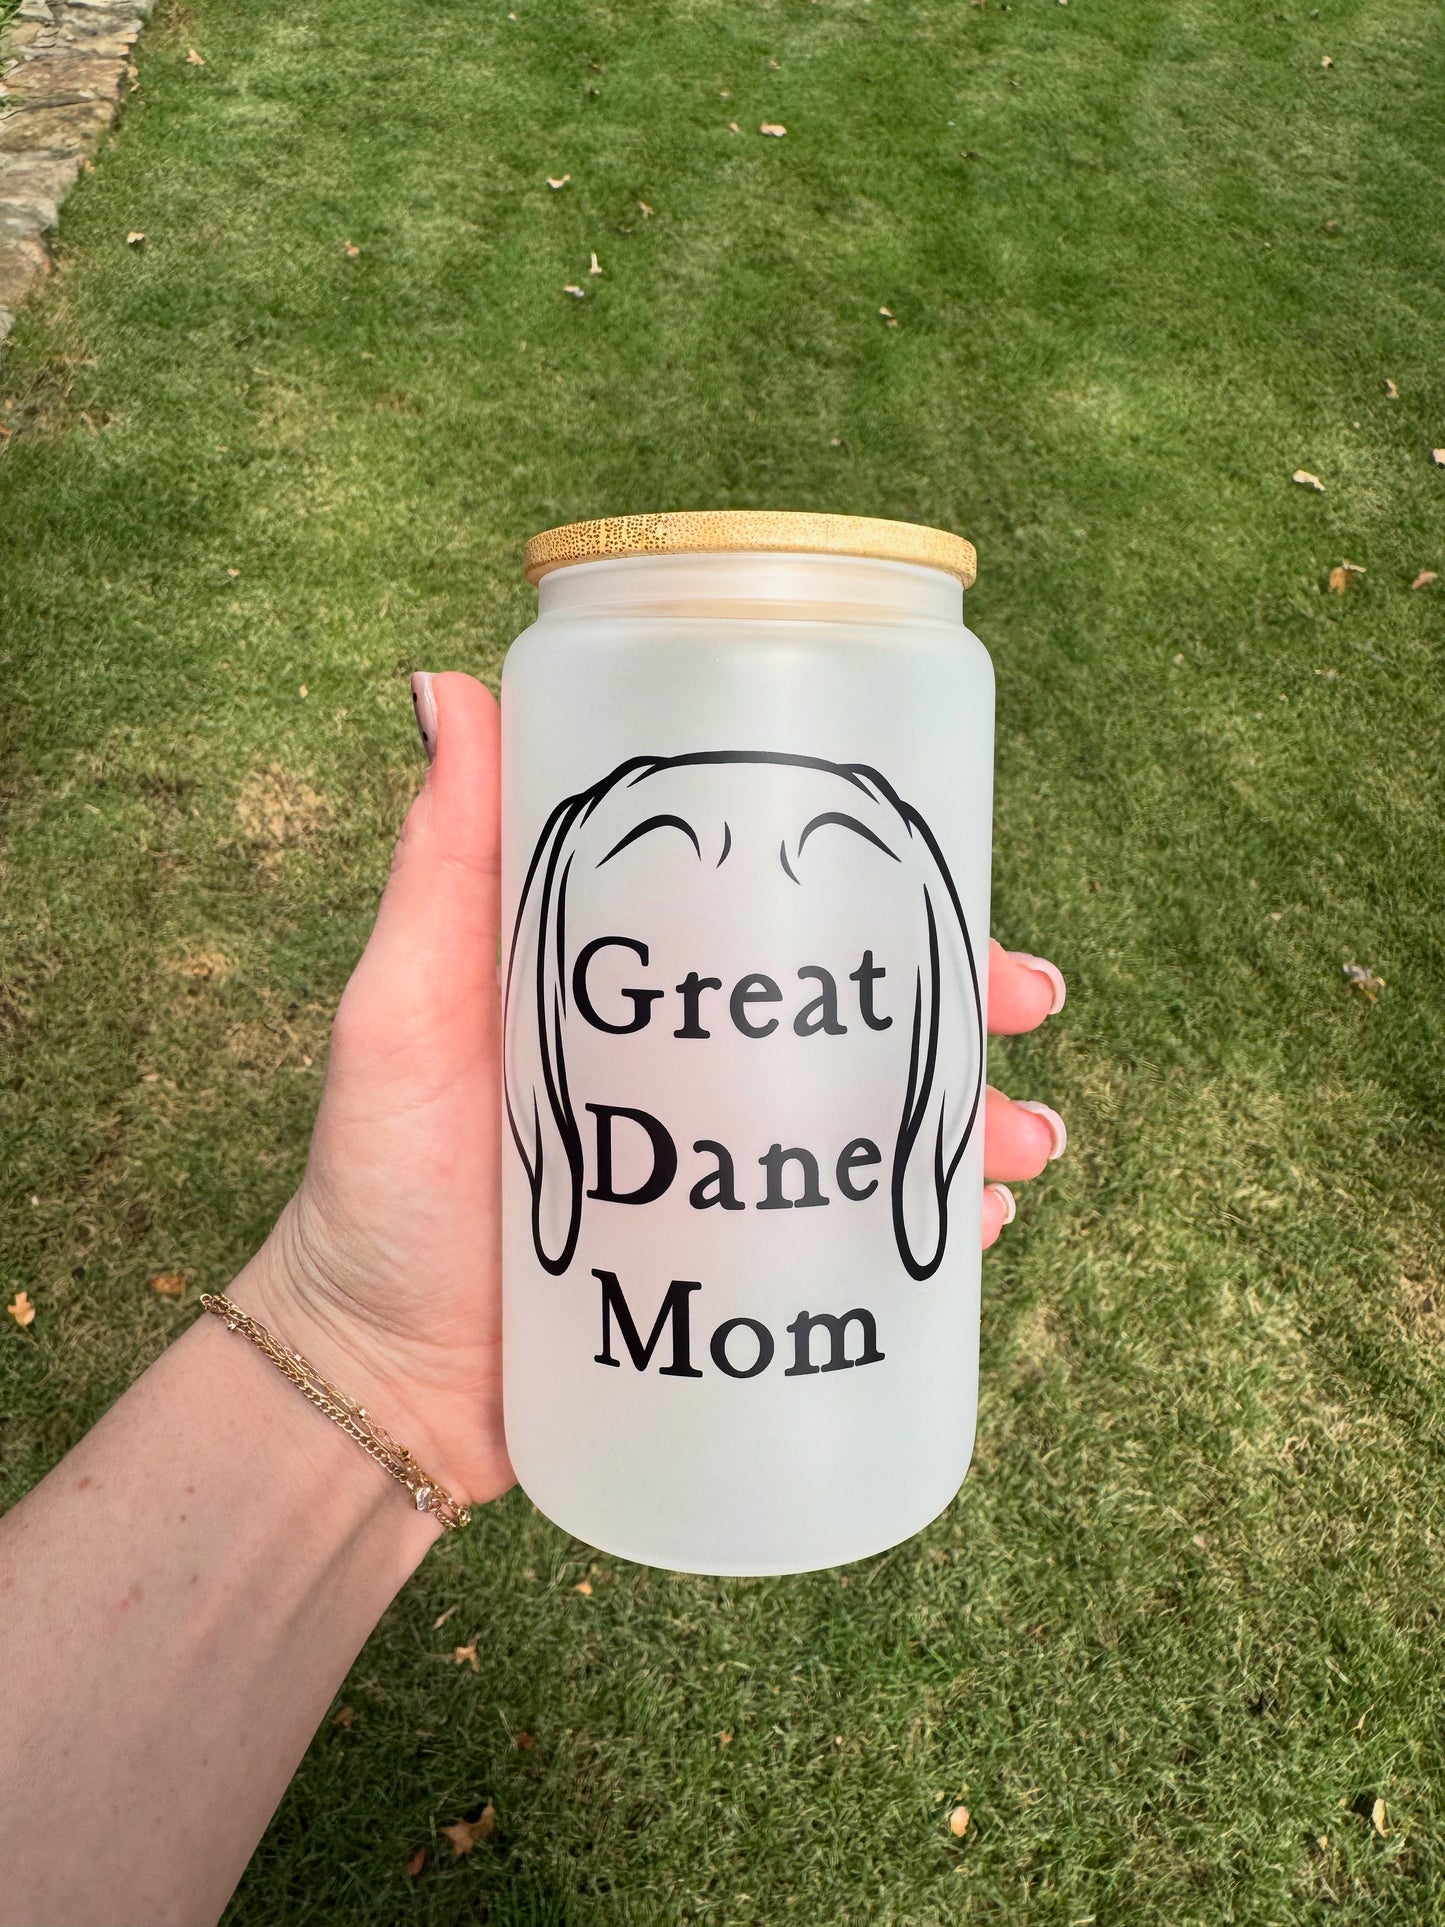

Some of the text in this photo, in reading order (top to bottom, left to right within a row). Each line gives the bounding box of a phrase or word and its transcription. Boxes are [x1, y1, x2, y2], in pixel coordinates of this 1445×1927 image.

[572, 935, 893, 1040] Great
[584, 1102, 882, 1211] Dane
[590, 1268, 886, 1379] Mom
